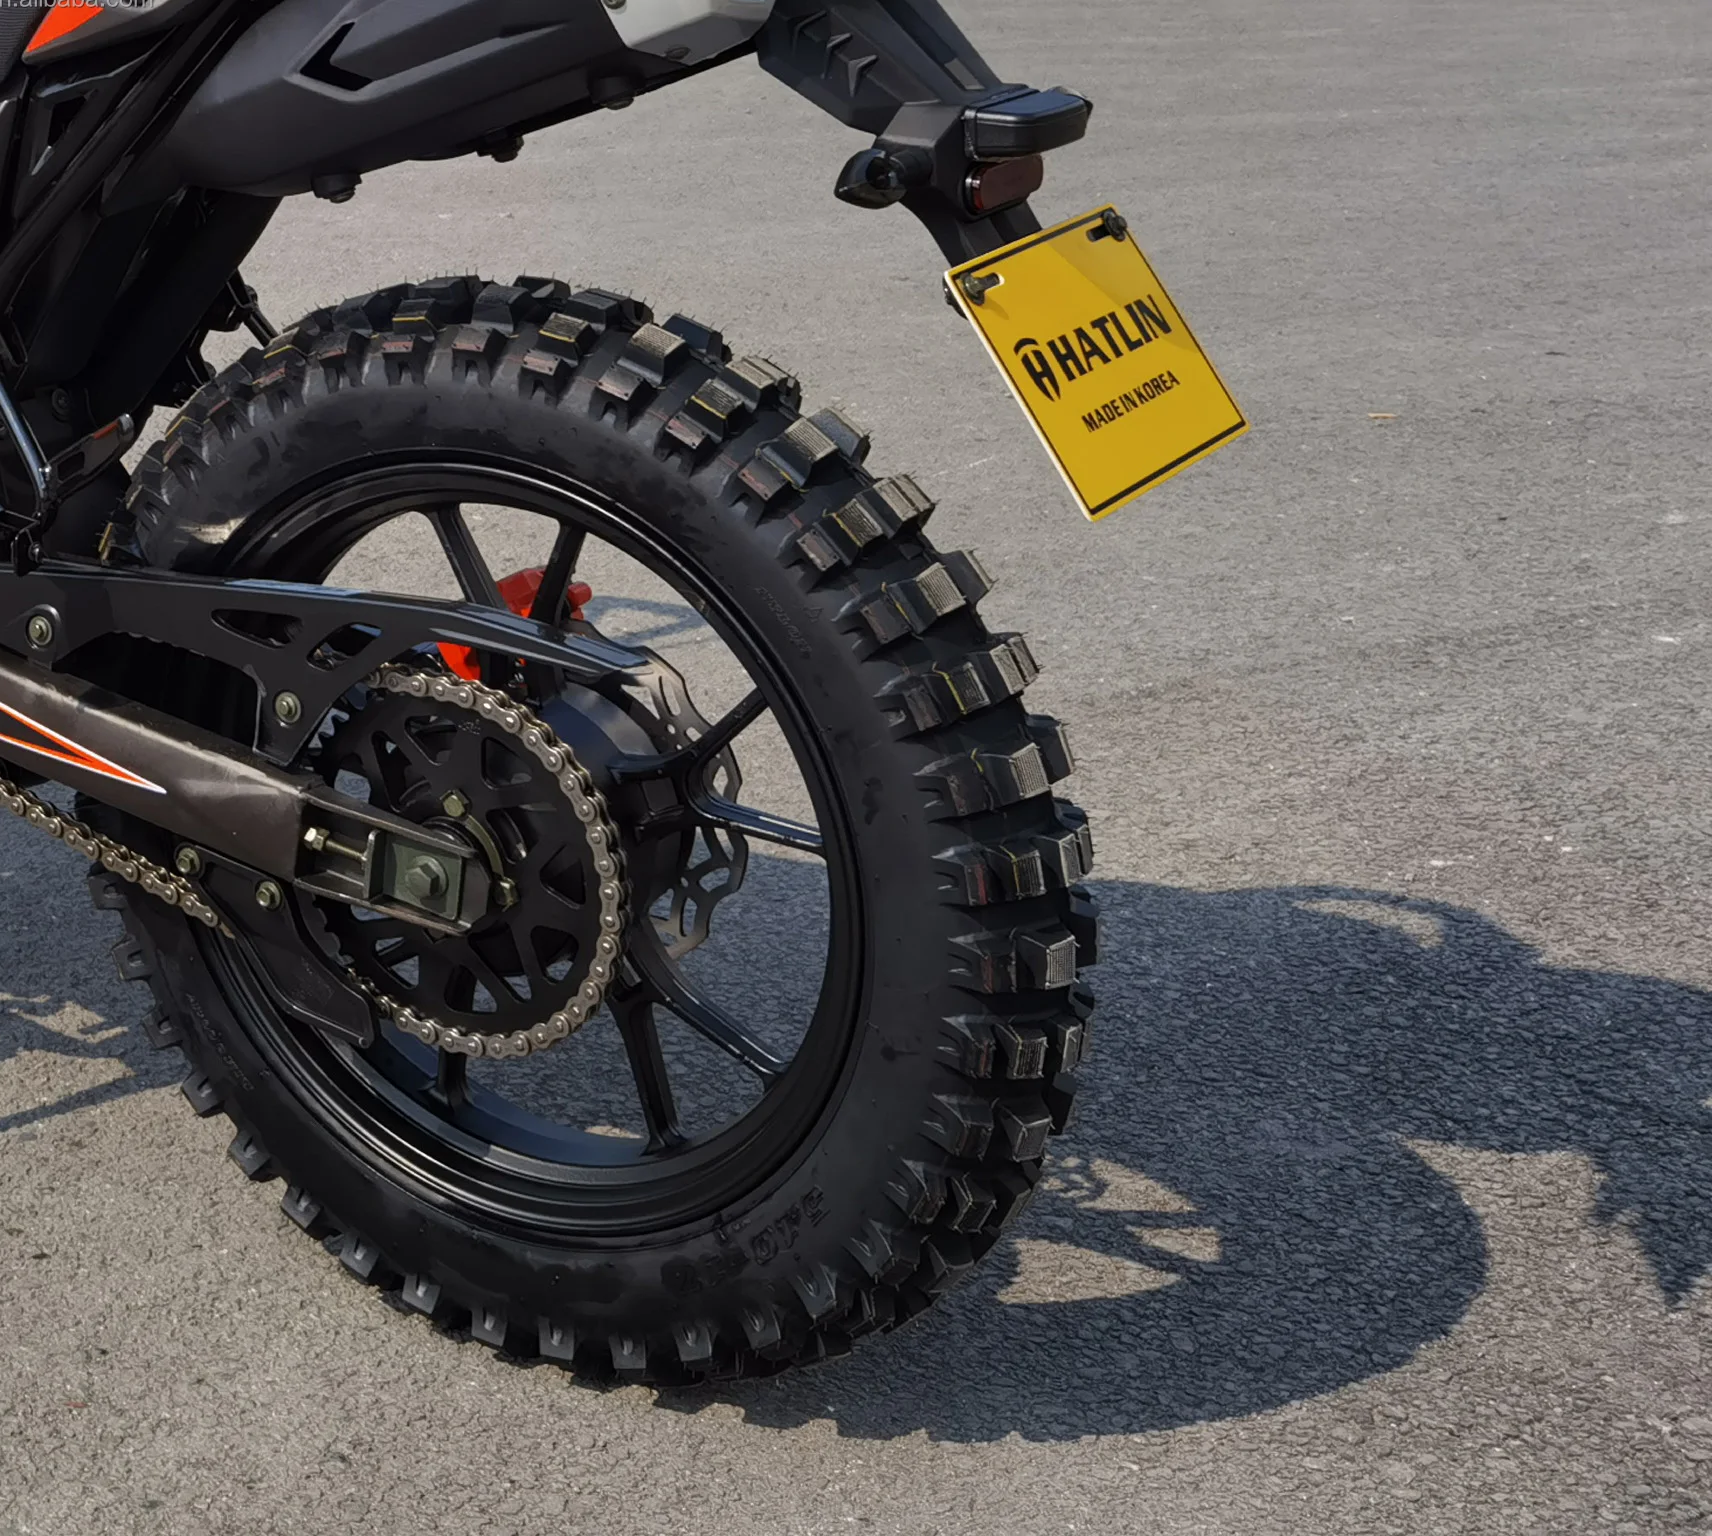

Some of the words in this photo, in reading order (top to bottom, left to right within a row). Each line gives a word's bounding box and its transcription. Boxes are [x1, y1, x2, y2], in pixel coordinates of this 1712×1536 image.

[1046, 294, 1172, 382] HATLIN
[1081, 399, 1123, 433] MADE
[1120, 391, 1139, 414] IN
[1136, 370, 1180, 407] KOREA
